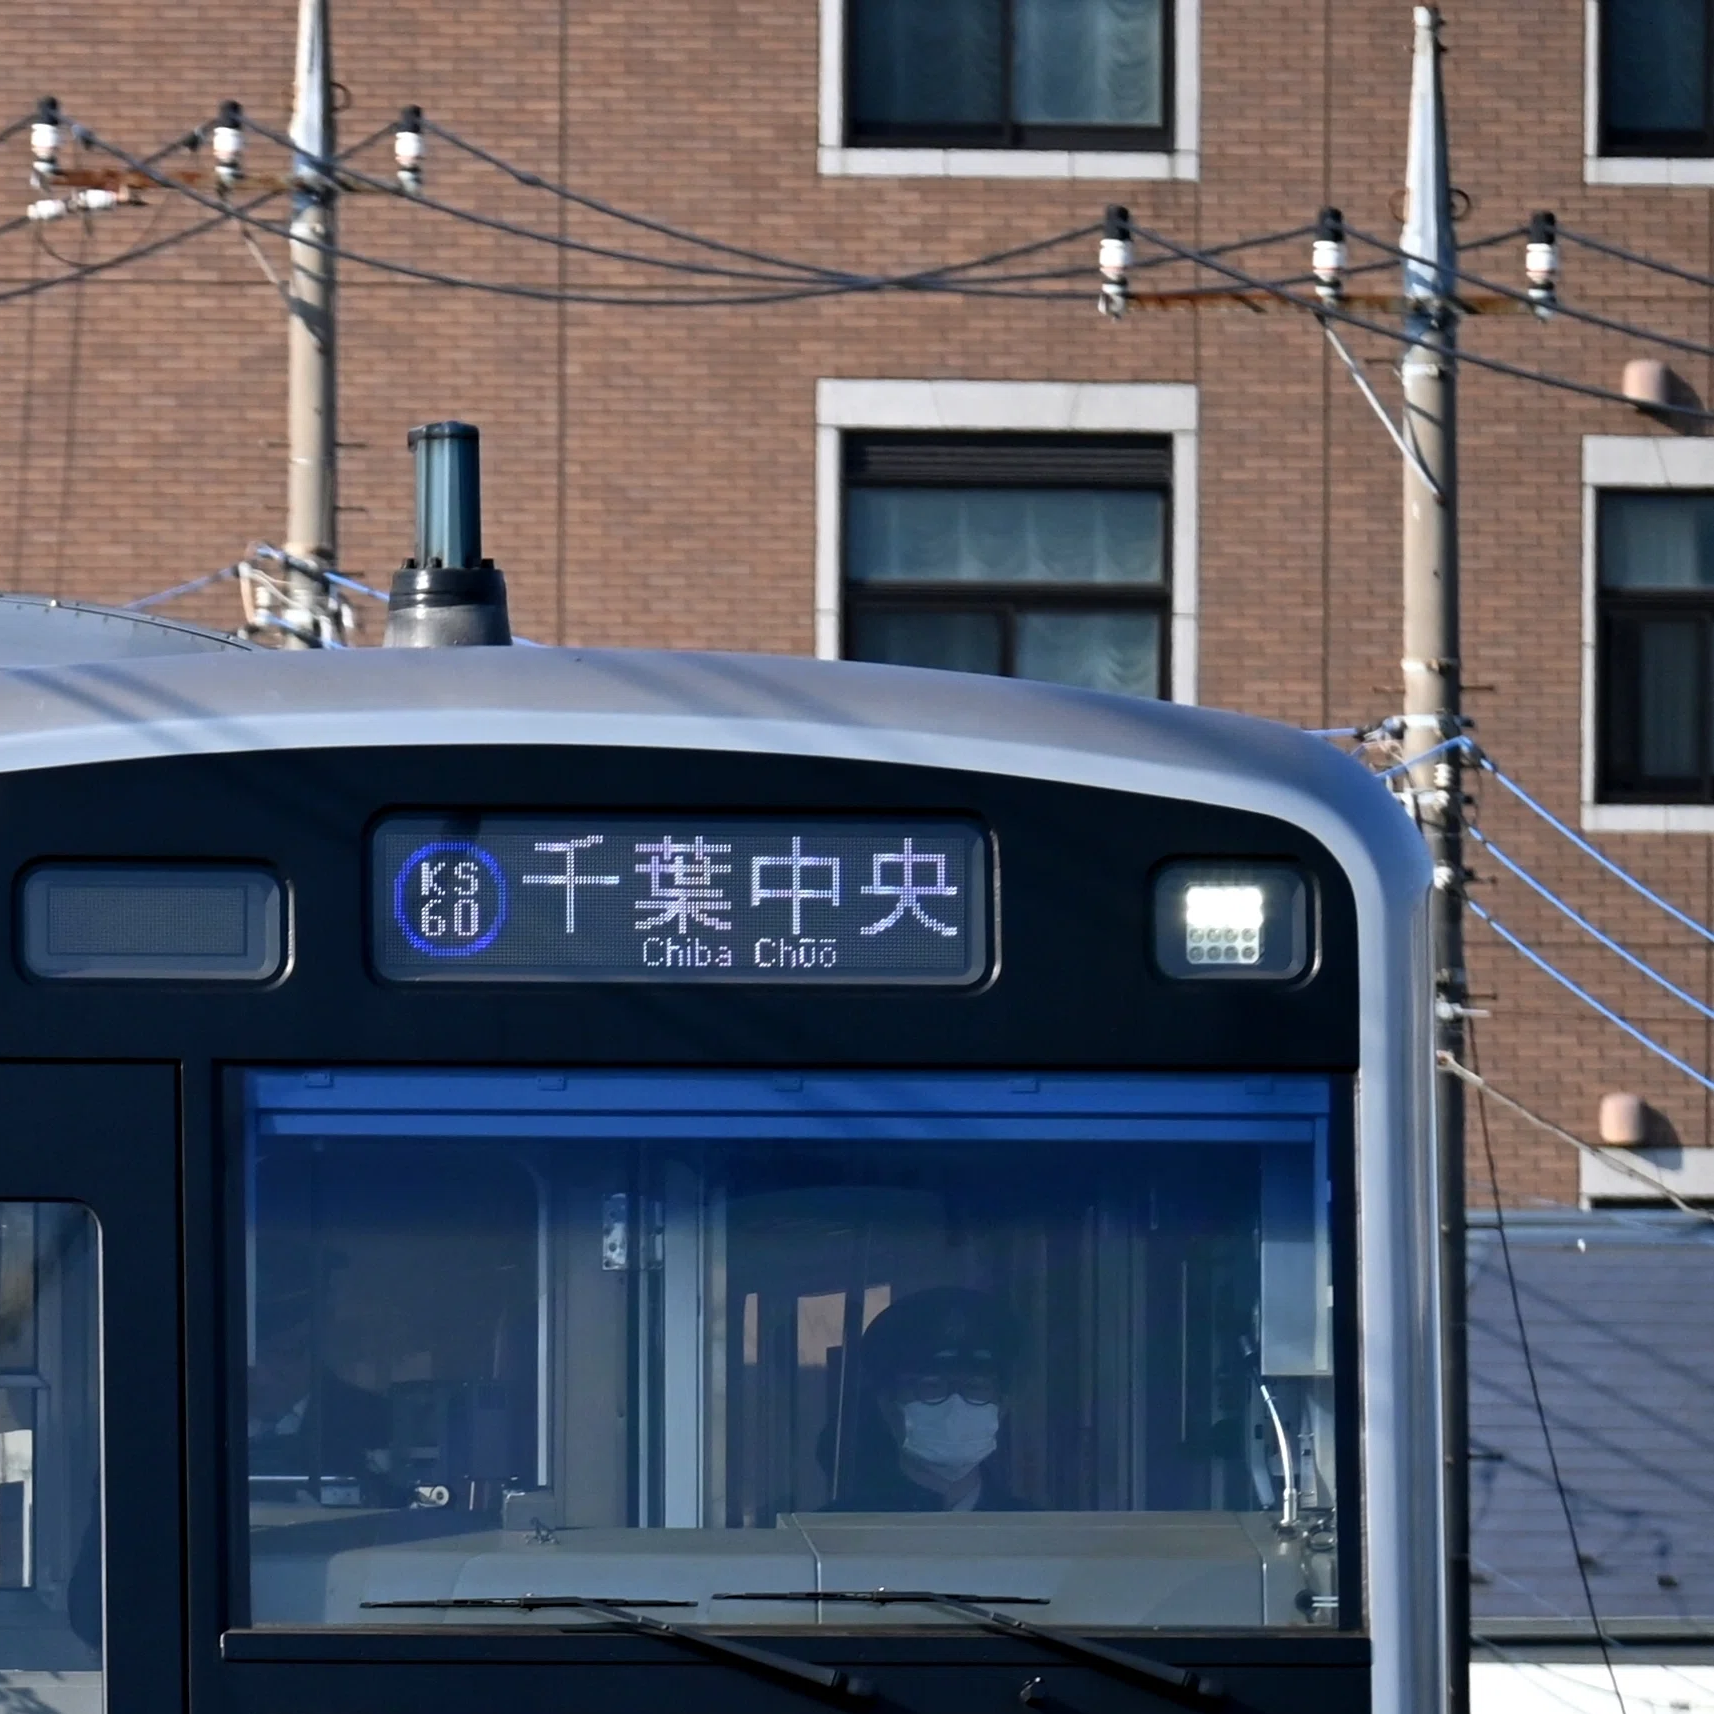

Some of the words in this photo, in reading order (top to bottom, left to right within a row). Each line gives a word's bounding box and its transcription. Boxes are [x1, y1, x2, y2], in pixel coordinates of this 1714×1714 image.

[421, 861, 479, 896] KS
[522, 834, 958, 937] 千葉中央
[421, 899, 479, 936] 60
[643, 937, 733, 967] Chiba
